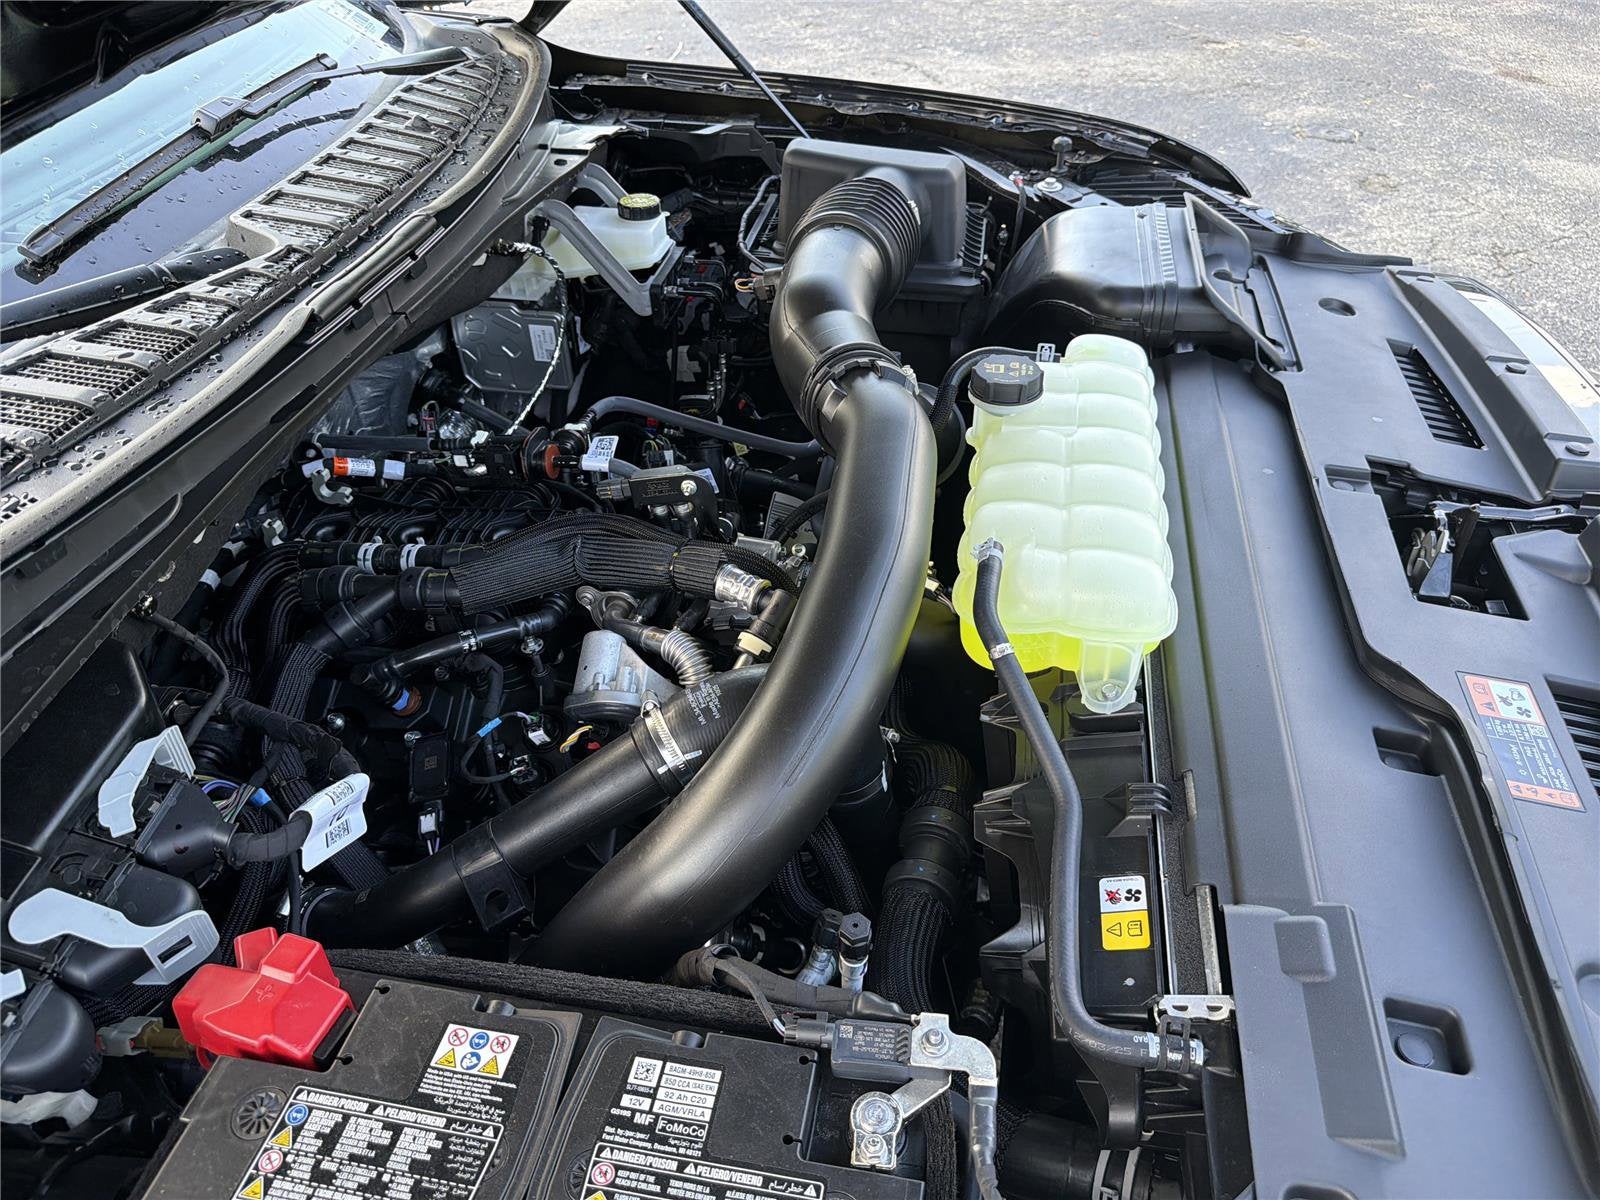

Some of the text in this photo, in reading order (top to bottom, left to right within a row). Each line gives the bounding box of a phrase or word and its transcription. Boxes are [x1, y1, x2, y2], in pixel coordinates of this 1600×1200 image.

[676, 1093, 688, 1102] Ah
[690, 1096, 707, 1104] C20
[308, 1091, 369, 1112] DANGER/POISON
[384, 1107, 447, 1127] PELIGRO/VENENO
[628, 1098, 706, 1118] 12V AGM/VRLA
[633, 1112, 656, 1126] MF
[659, 1120, 705, 1137] FoMoCo
[612, 1149, 678, 1170] DANGER/POISON
[696, 1165, 763, 1186] PELIGRO/VENENO
